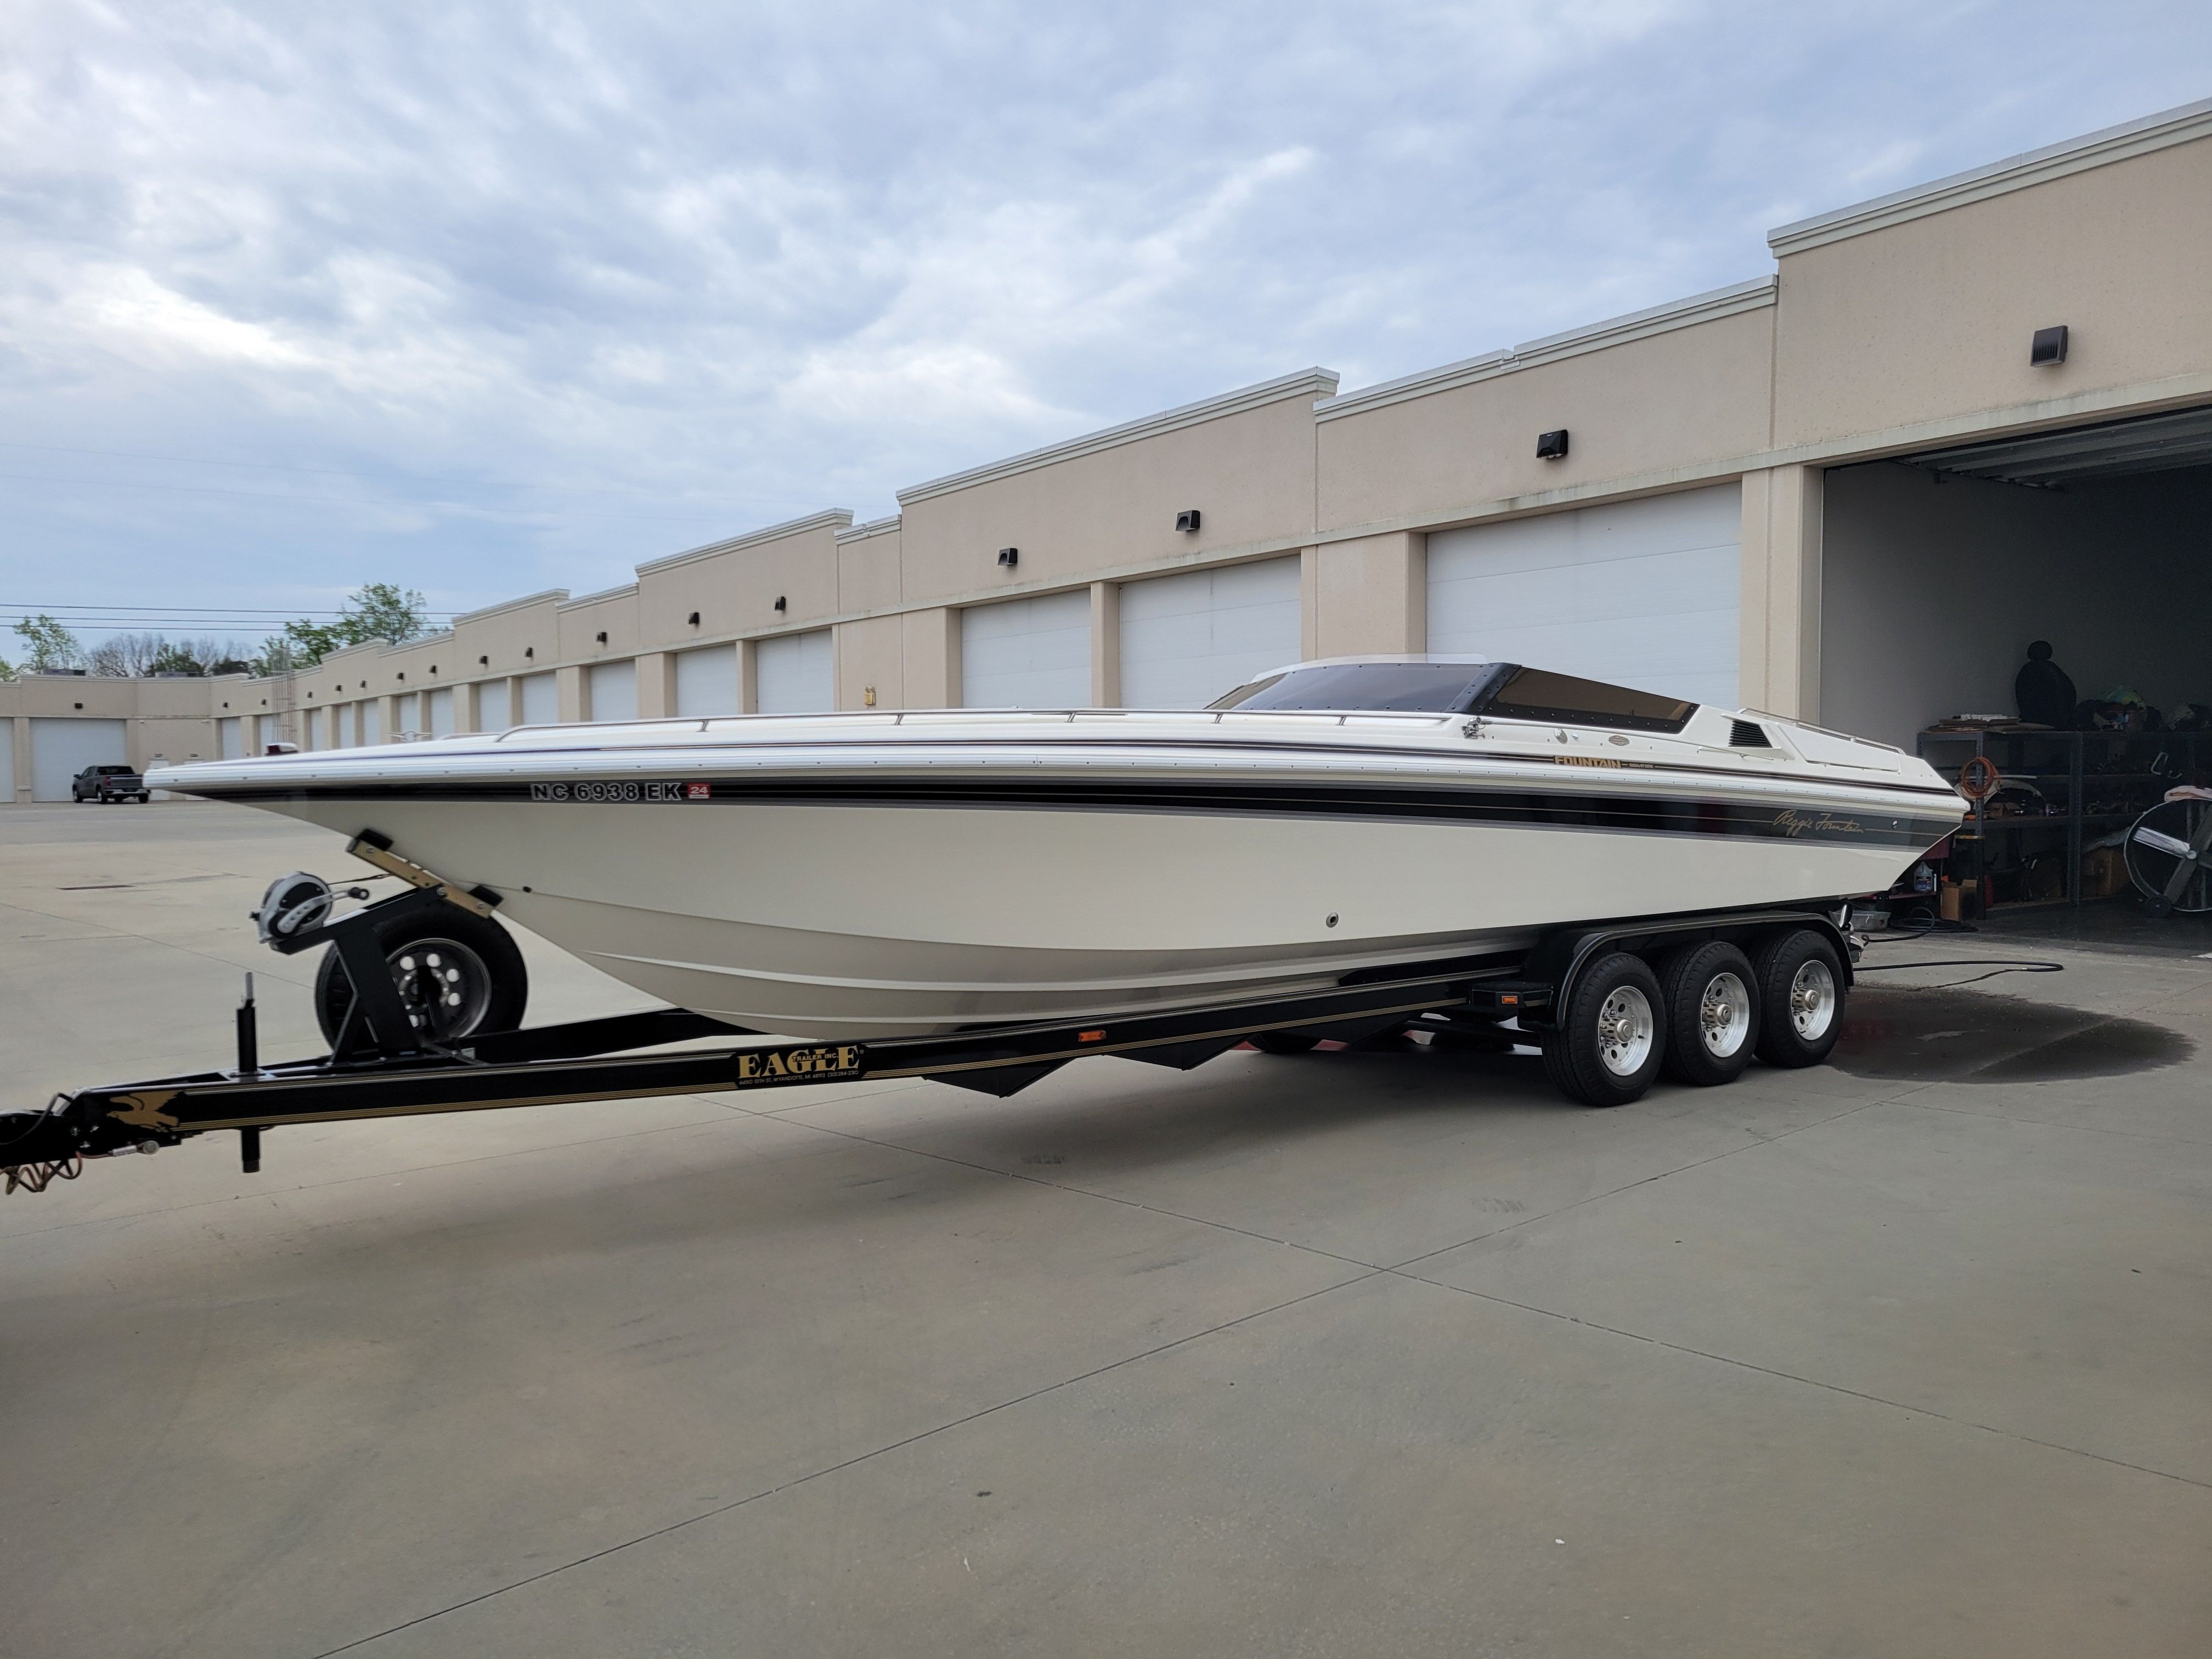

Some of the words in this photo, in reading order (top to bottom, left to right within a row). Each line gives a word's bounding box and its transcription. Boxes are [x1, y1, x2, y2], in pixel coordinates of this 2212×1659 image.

[1554, 756, 1622, 769] FOUNTAIN
[530, 783, 569, 801] NC
[574, 782, 639, 802] 6938
[645, 782, 682, 801] EK
[690, 786, 708, 794] 24
[1773, 809, 1813, 837] Reggie
[1815, 812, 1864, 833] Fountain
[737, 1045, 860, 1079] EAGLE
[792, 1054, 822, 1063] TRAILER
